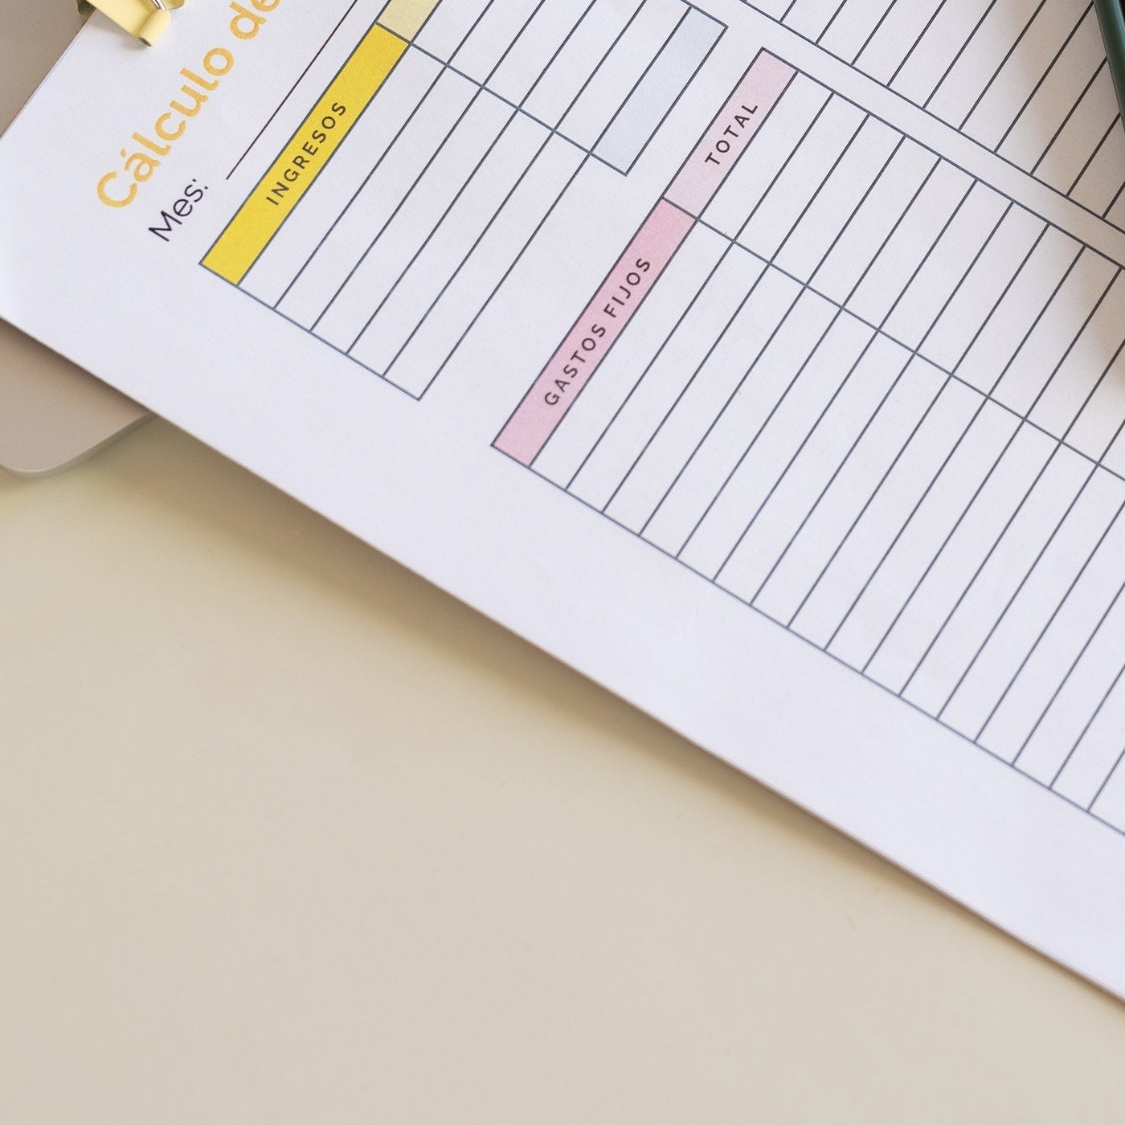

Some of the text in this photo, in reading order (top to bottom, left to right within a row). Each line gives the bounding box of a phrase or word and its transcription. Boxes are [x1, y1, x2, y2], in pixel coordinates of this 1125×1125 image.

[96, 45, 235, 209] Cálculo
[265, 100, 347, 206] INGRESOS
[704, 104, 759, 167] TOTAL
[148, 179, 209, 242] Mes:
[544, 257, 651, 407] GASTOS FIJOS
